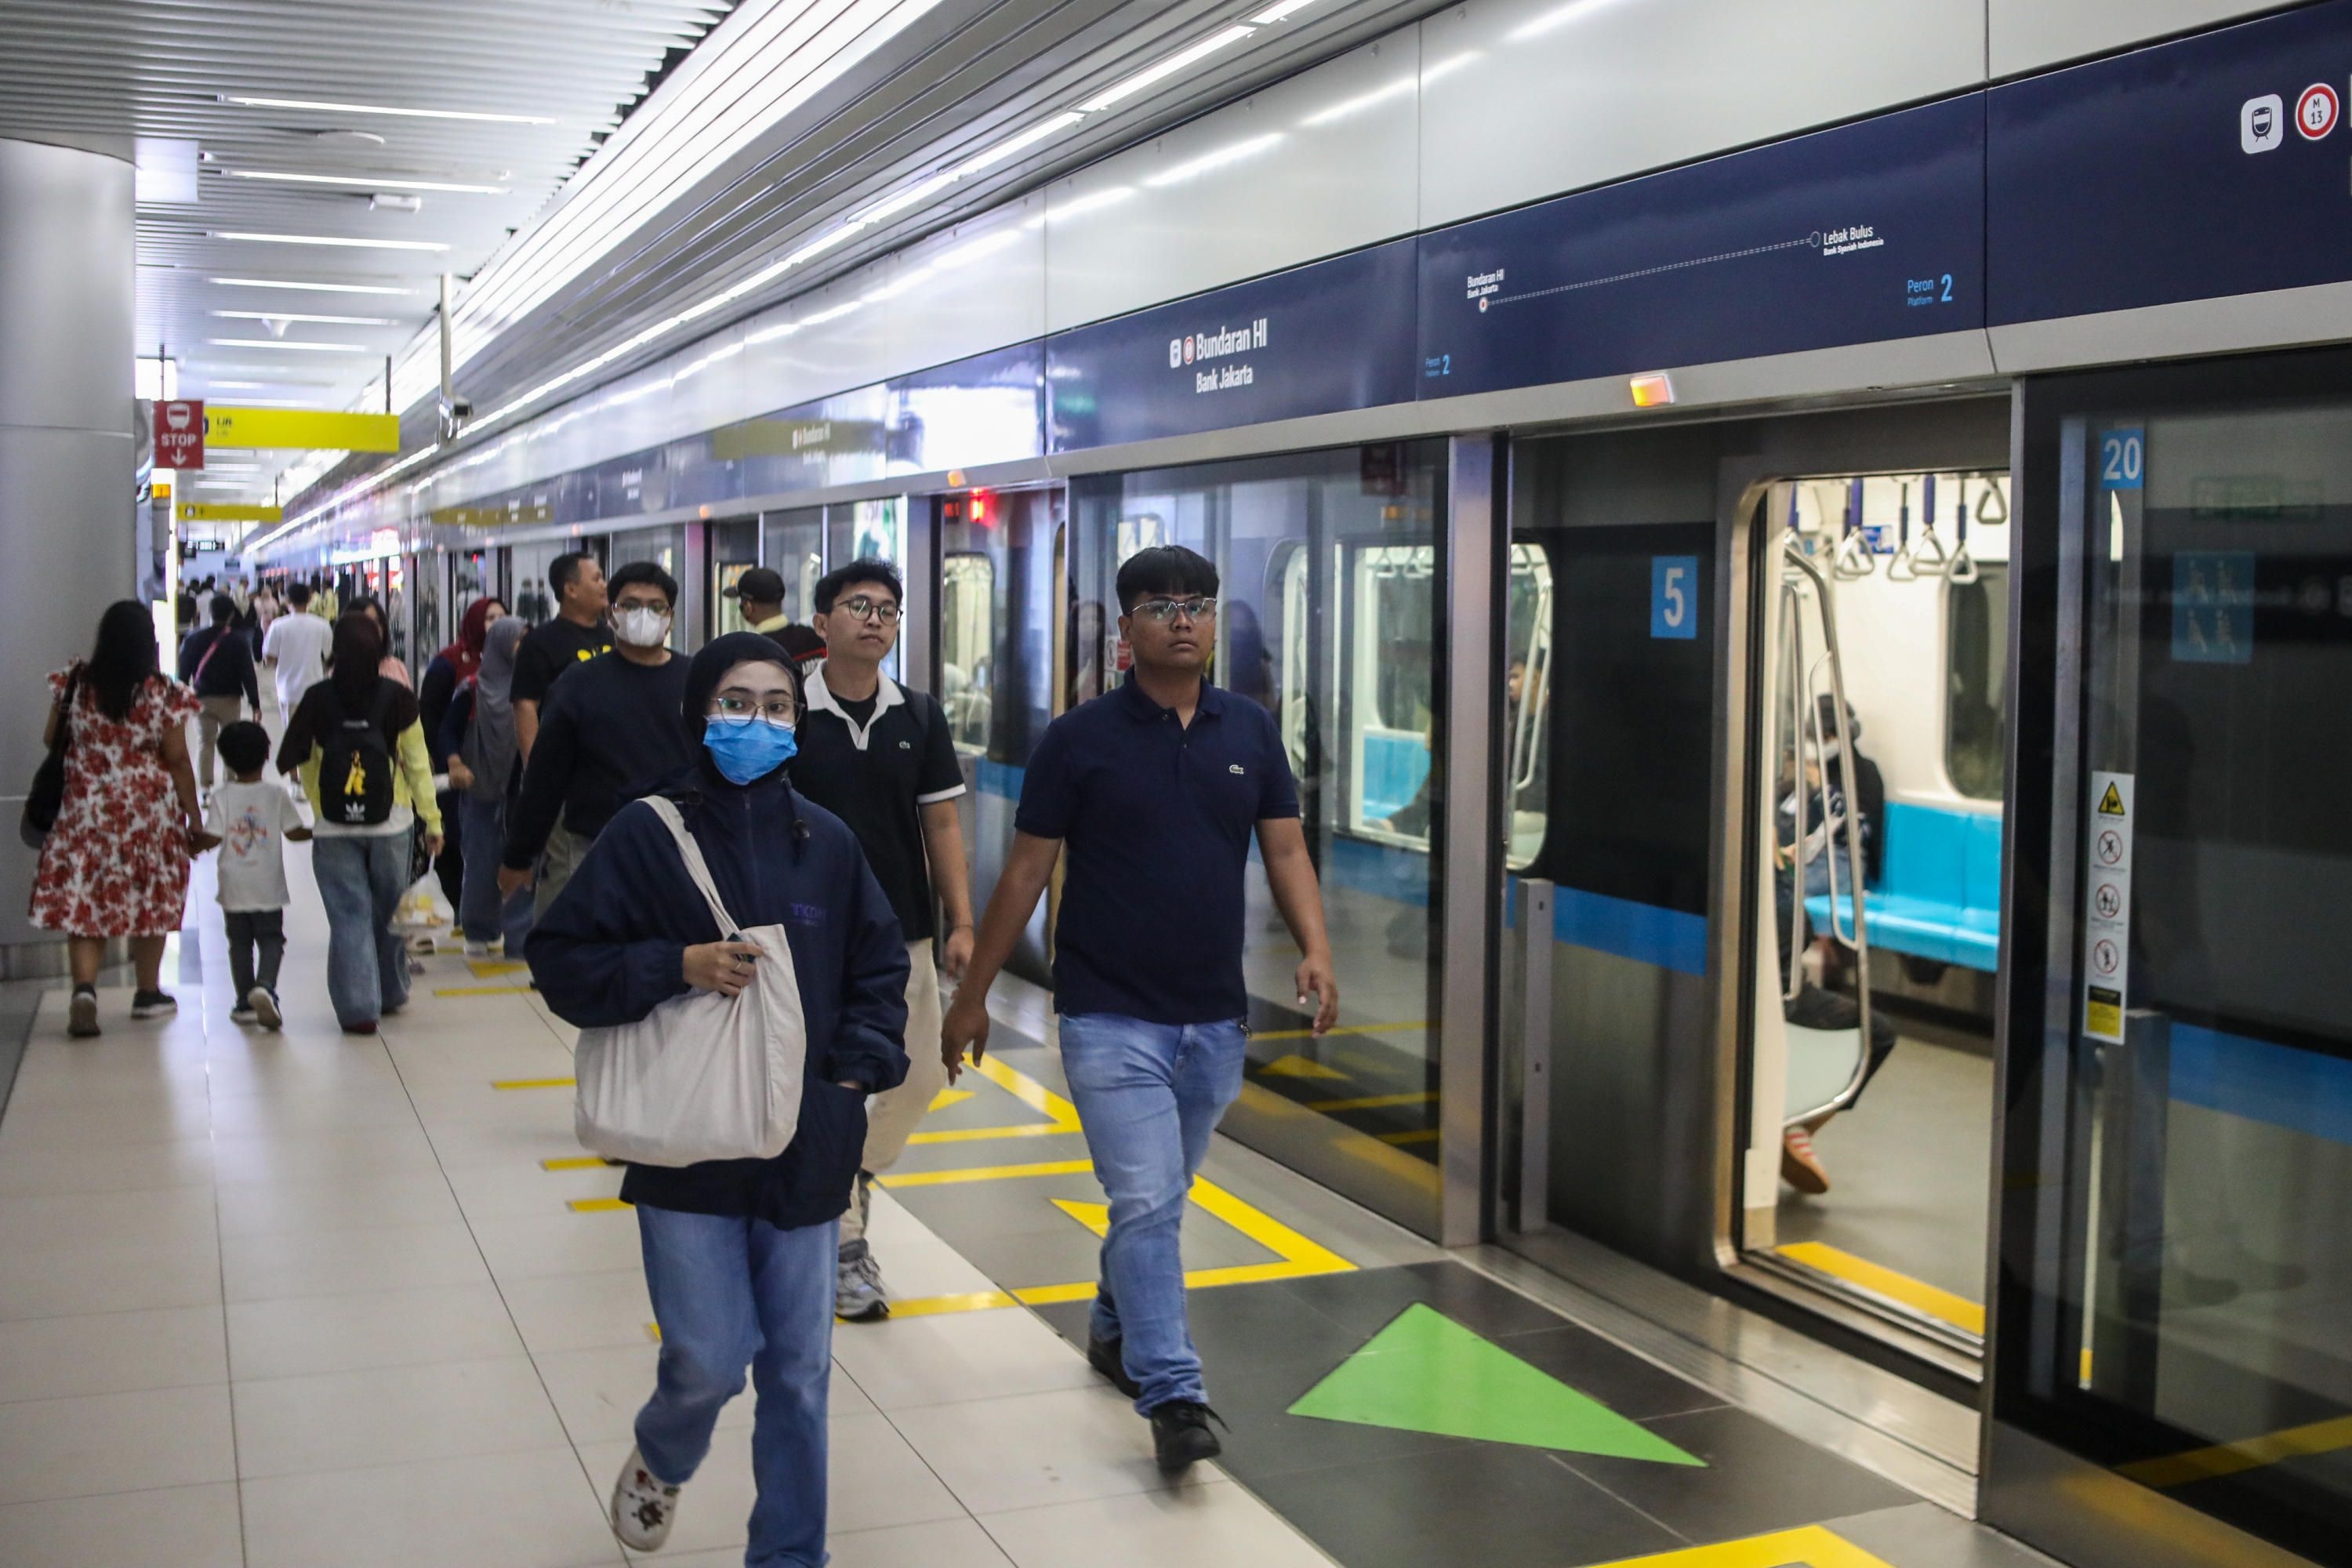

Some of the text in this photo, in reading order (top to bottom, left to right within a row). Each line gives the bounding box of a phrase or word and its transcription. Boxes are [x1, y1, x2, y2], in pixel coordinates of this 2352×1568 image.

[2313, 98, 2320, 108] M
[2311, 111, 2322, 125] 13
[1824, 225, 1873, 245] Lebak Bulus
[1824, 246, 1837, 256] Bank
[1858, 237, 1884, 249] Indonesia
[1468, 268, 1504, 288] Bundaran HI
[1907, 274, 1952, 302] Peron 2
[1196, 318, 1267, 361] Bundaran HI
[1443, 354, 1450, 375] 2
[1196, 364, 1253, 393] Bank Jakarta
[161, 433, 196, 447] STOP
[2103, 437, 2140, 480] 20
[1664, 568, 1684, 627] 5
